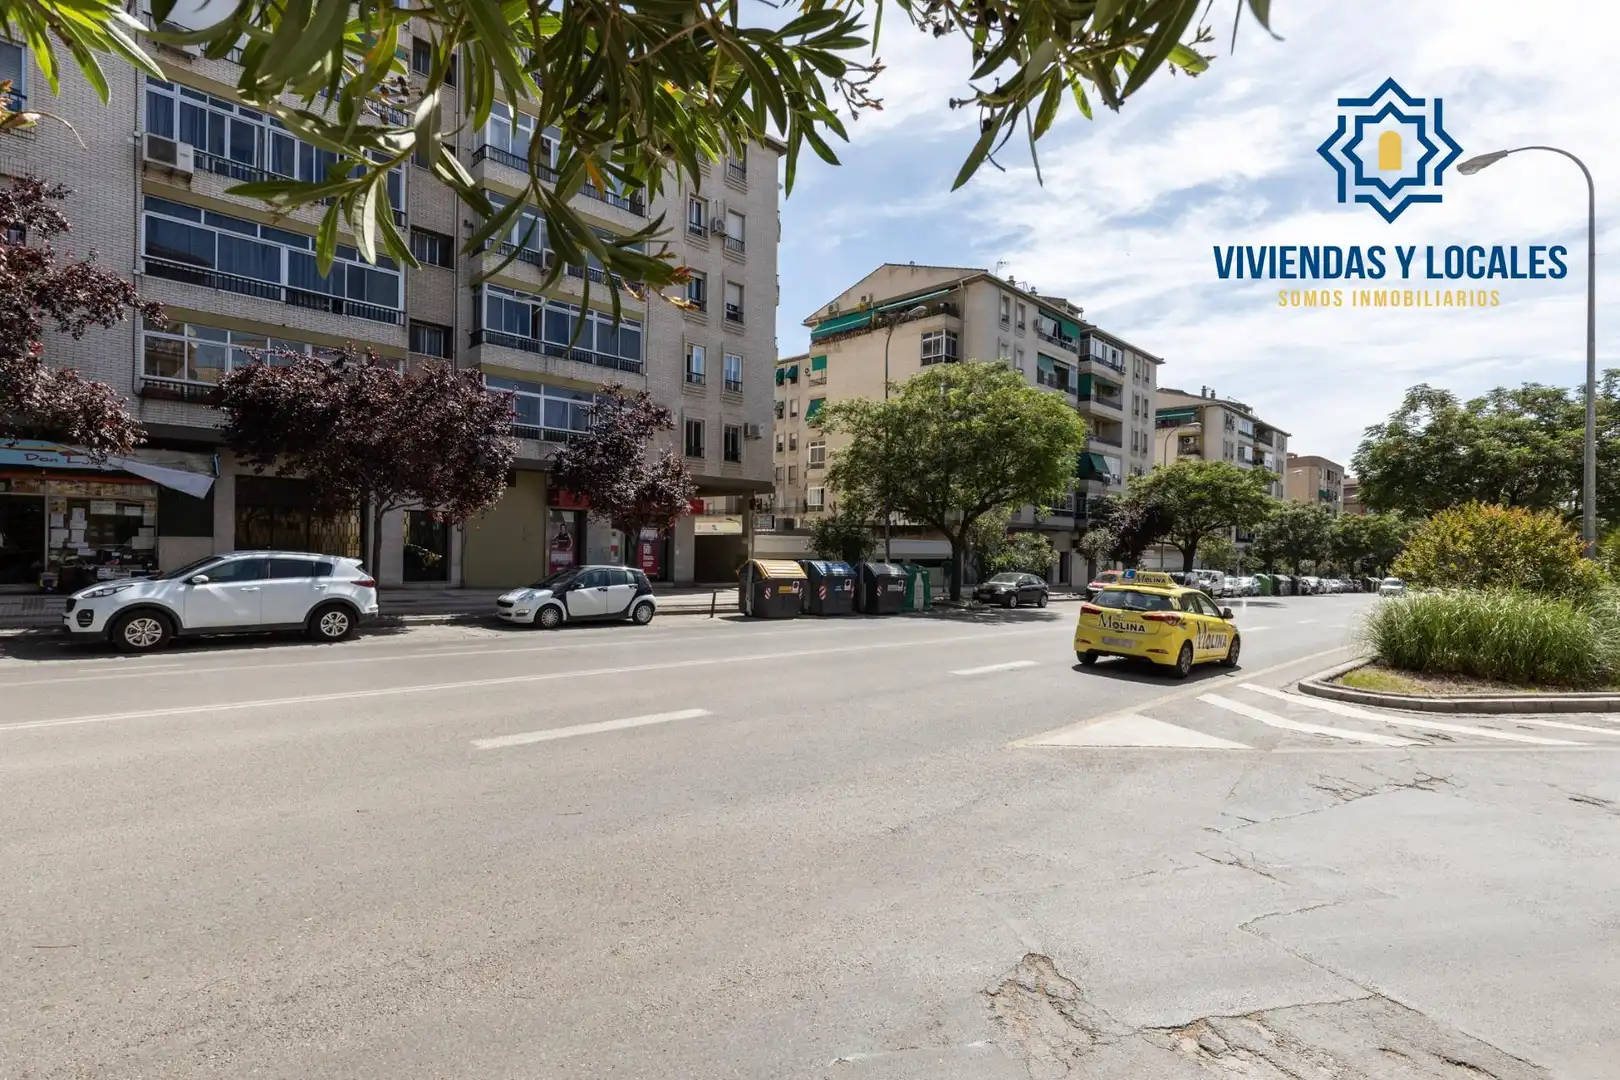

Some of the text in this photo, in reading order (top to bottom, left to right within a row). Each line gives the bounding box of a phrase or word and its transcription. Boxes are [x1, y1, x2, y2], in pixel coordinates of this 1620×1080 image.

[1137, 574, 1166, 583] MOLINA
[1099, 614, 1146, 632] MOLINA
[1196, 620, 1228, 649] MOLINA
